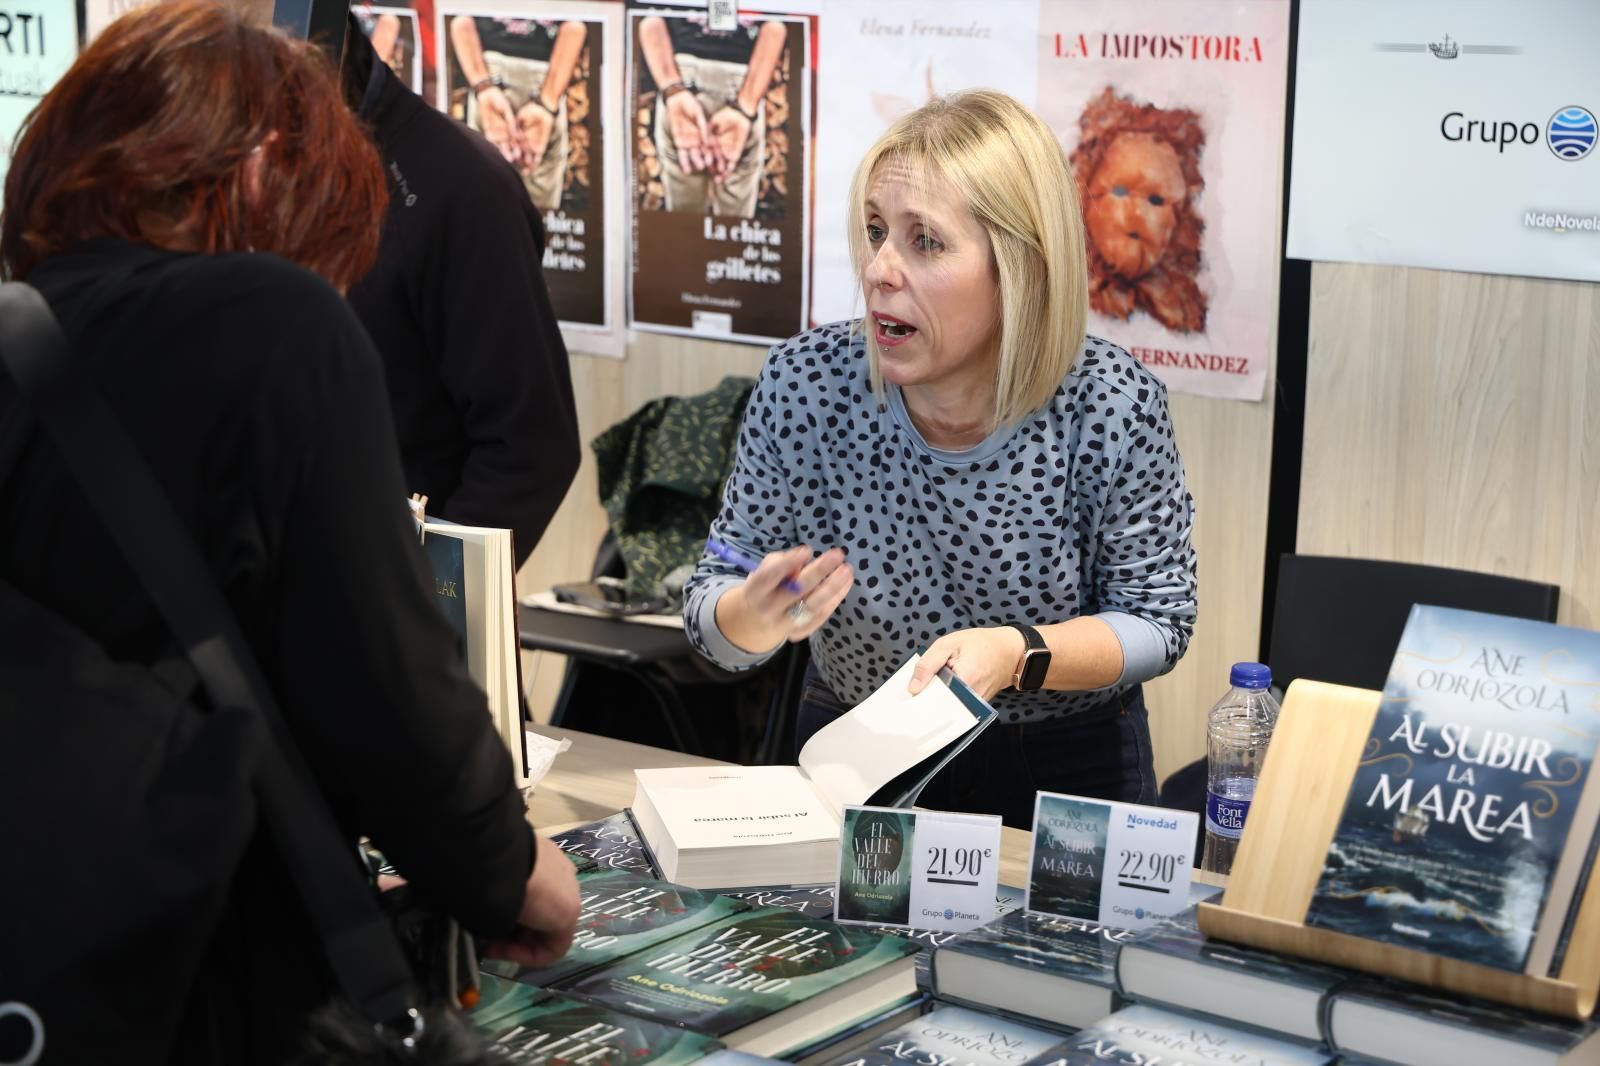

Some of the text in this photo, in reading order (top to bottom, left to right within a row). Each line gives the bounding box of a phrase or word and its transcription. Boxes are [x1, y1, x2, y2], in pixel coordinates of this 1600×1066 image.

[859, 17, 904, 37] Elena
[1055, 32, 1263, 62] LA IMPOSTORA
[1440, 112, 1540, 153] Grupo
[704, 216, 781, 246] La chica
[706, 256, 782, 284] grilletes
[1130, 346, 1249, 375] FERNANDEZ
[1470, 647, 1527, 678] ANE
[1388, 713, 1553, 779] AL SUBIR
[1446, 764, 1475, 786] LA
[1127, 813, 1178, 830] Novedad
[1216, 814, 1243, 829] Vella
[1217, 803, 1243, 818] Font
[1366, 773, 1535, 843] MAREA
[1040, 857, 1095, 878] MAREA
[921, 908, 980, 921] Grupo Planeta
[713, 927, 829, 964] VALLE
[627, 974, 658, 988] Ane
[645, 952, 792, 994] HIERRO
